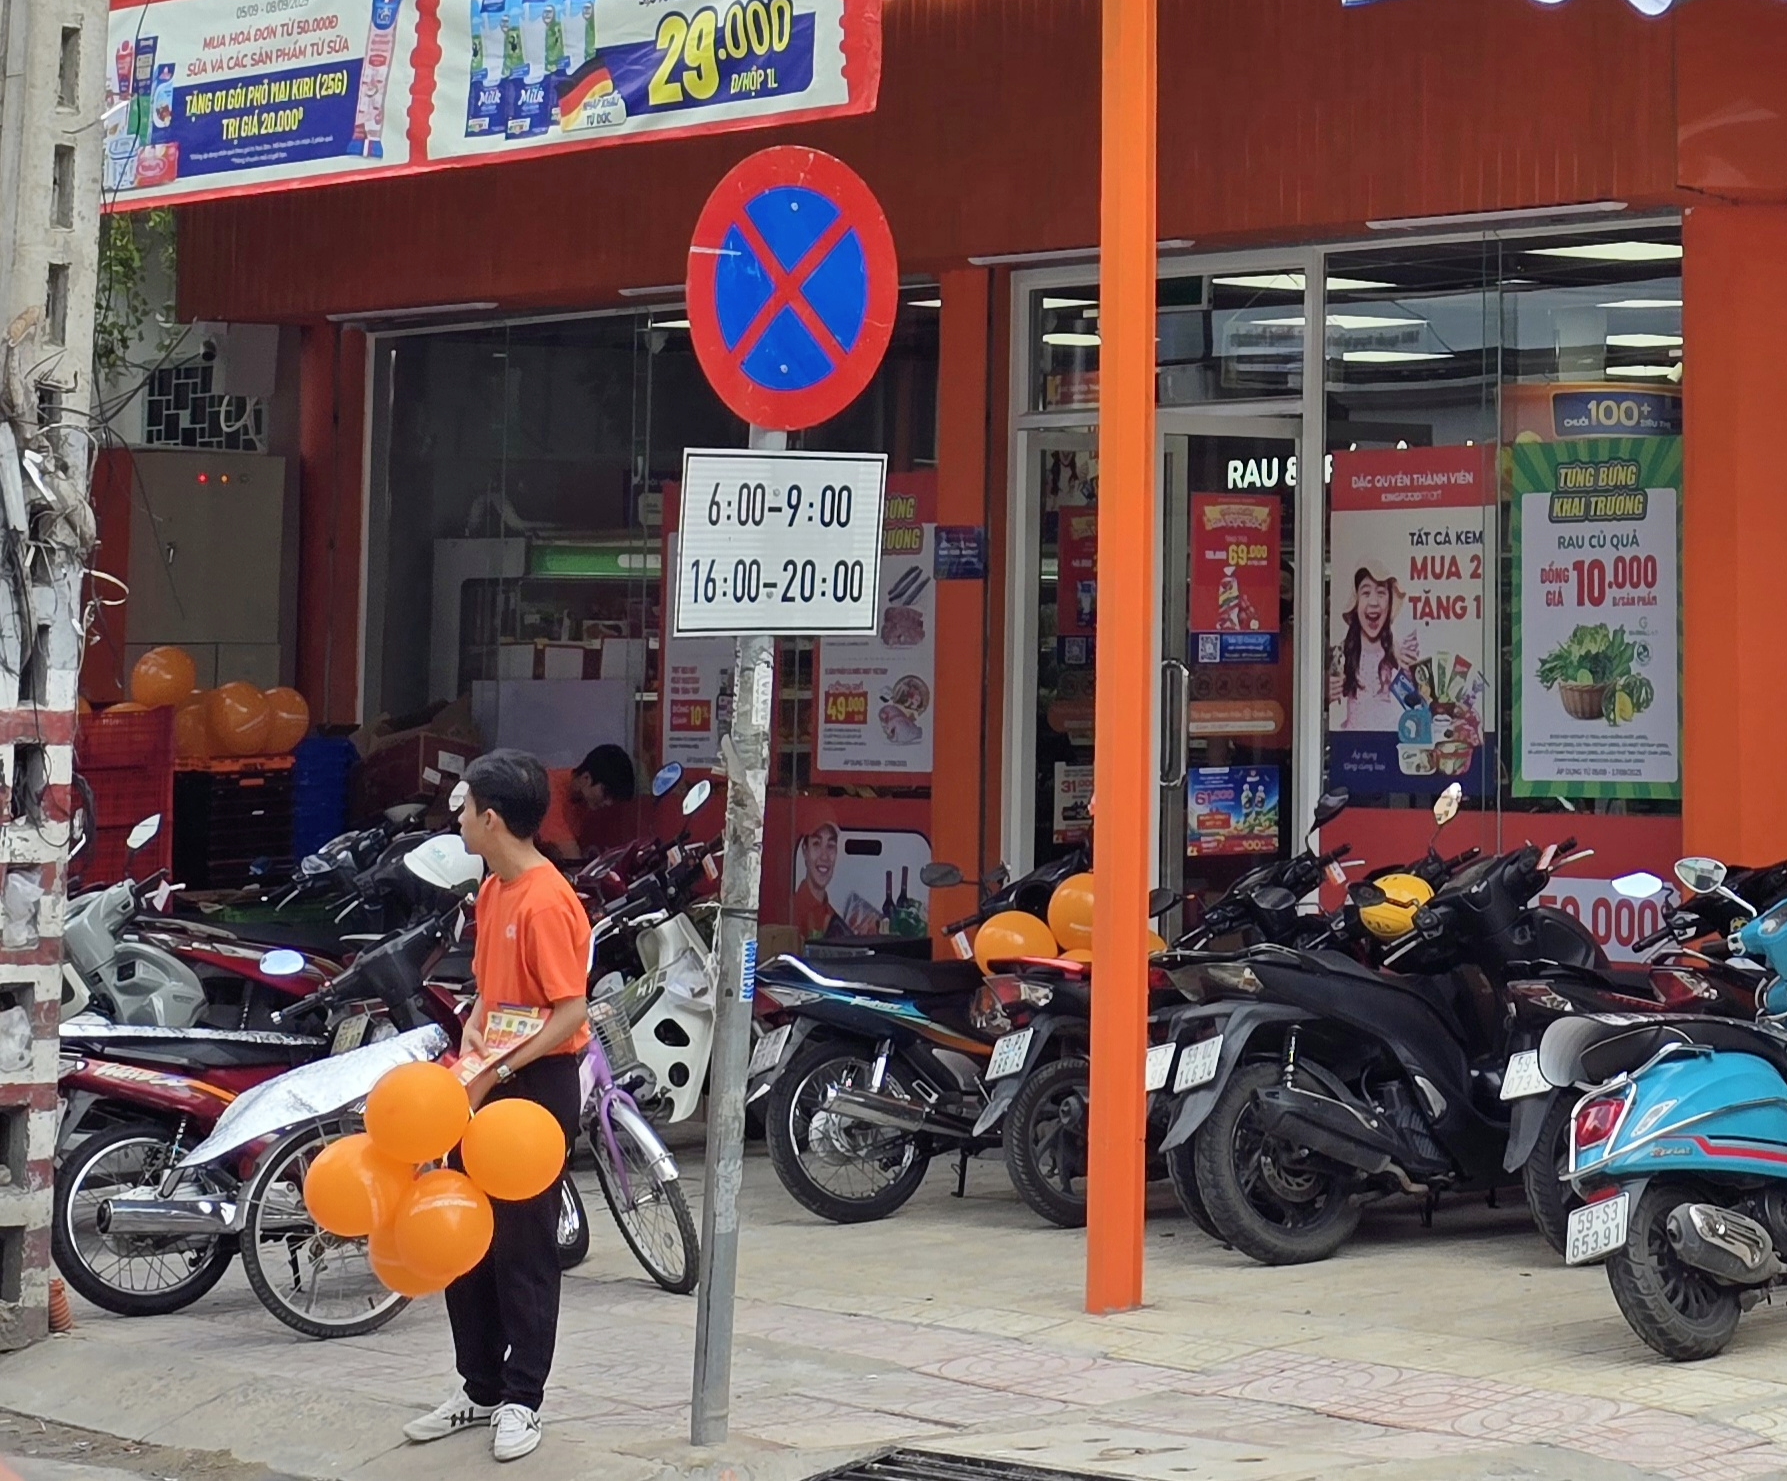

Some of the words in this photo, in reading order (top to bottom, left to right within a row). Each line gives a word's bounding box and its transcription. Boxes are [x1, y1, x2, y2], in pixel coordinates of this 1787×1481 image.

[202, 34, 227, 51] MUA
[186, 59, 209, 78] SỮA
[210, 55, 225, 73] VÀ
[226, 50, 249, 70] CÁC
[185, 91, 212, 122] TẶNG
[227, 85, 245, 109] GÓI
[271, 79, 289, 103] MAI
[222, 119, 239, 145] TRỊ
[241, 111, 259, 137] GIÁ
[1227, 457, 1279, 490] RAU
[1352, 473, 1372, 490] ĐẶC
[1375, 471, 1410, 487] QUYỀN
[1413, 472, 1447, 485] THÀNH
[1449, 470, 1473, 484] VIÊN
[1553, 496, 1585, 517] KHAI
[1409, 528, 1431, 546] TẤT
[1434, 526, 1451, 546] CẢ
[1456, 531, 1483, 545] KEM
[1557, 535, 1585, 550] RAU
[1589, 529, 1607, 549] CỦ
[1611, 529, 1640, 551] QUẢ
[1410, 555, 1462, 581] MUA
[1470, 554, 1481, 579] 2
[1540, 561, 1570, 584] ĐỒNG
[1572, 554, 1657, 608] 10.000
[1409, 589, 1467, 626] TẶNG
[1474, 595, 1481, 619] 1
[1545, 589, 1564, 607] GIÁ
[1577, 1201, 1619, 1234] 59-S3
[1572, 1223, 1620, 1259] 653.91
